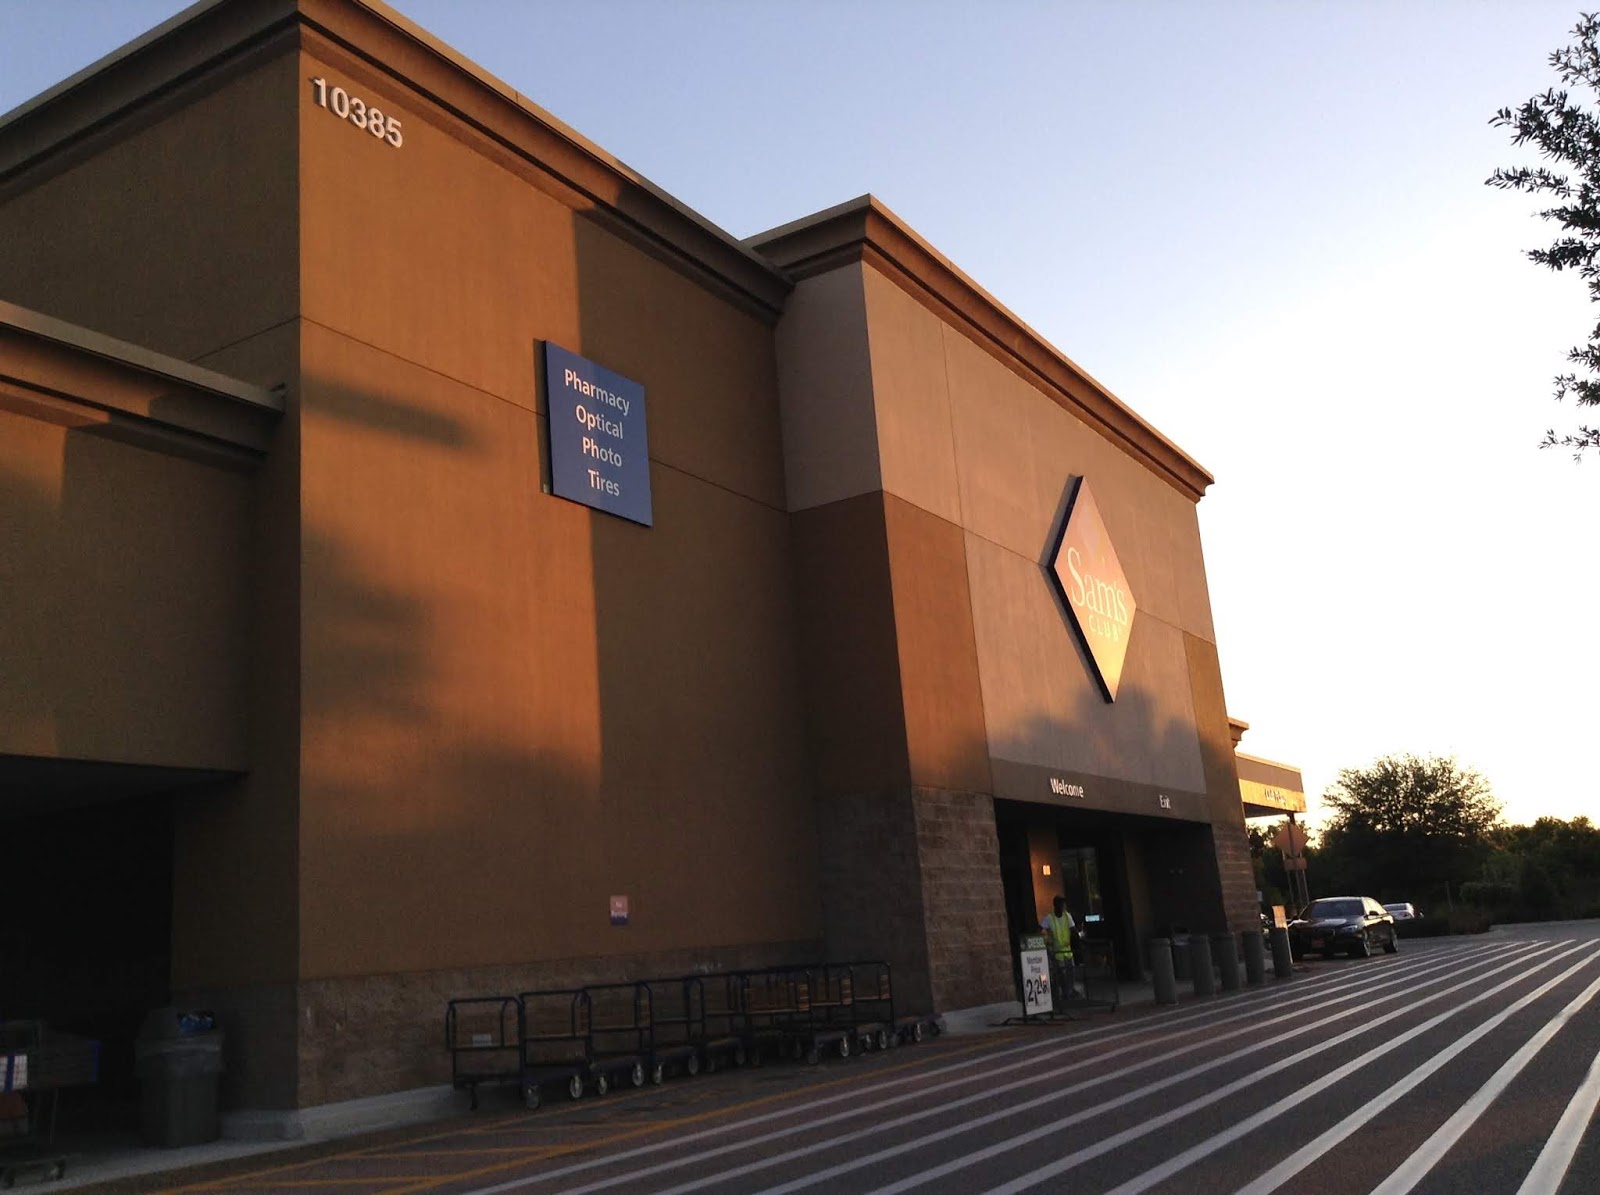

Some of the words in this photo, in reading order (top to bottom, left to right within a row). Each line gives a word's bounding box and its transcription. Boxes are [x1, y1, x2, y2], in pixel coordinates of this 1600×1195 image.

[313, 77, 403, 149] 10385
[564, 368, 630, 417] Pharmacy
[575, 404, 624, 440] Optical
[582, 436, 622, 468] Photo
[587, 468, 620, 497] Tires
[1067, 546, 1128, 626] Sam's
[1088, 614, 1120, 641] CLUB
[1050, 778, 1084, 799] Welcome
